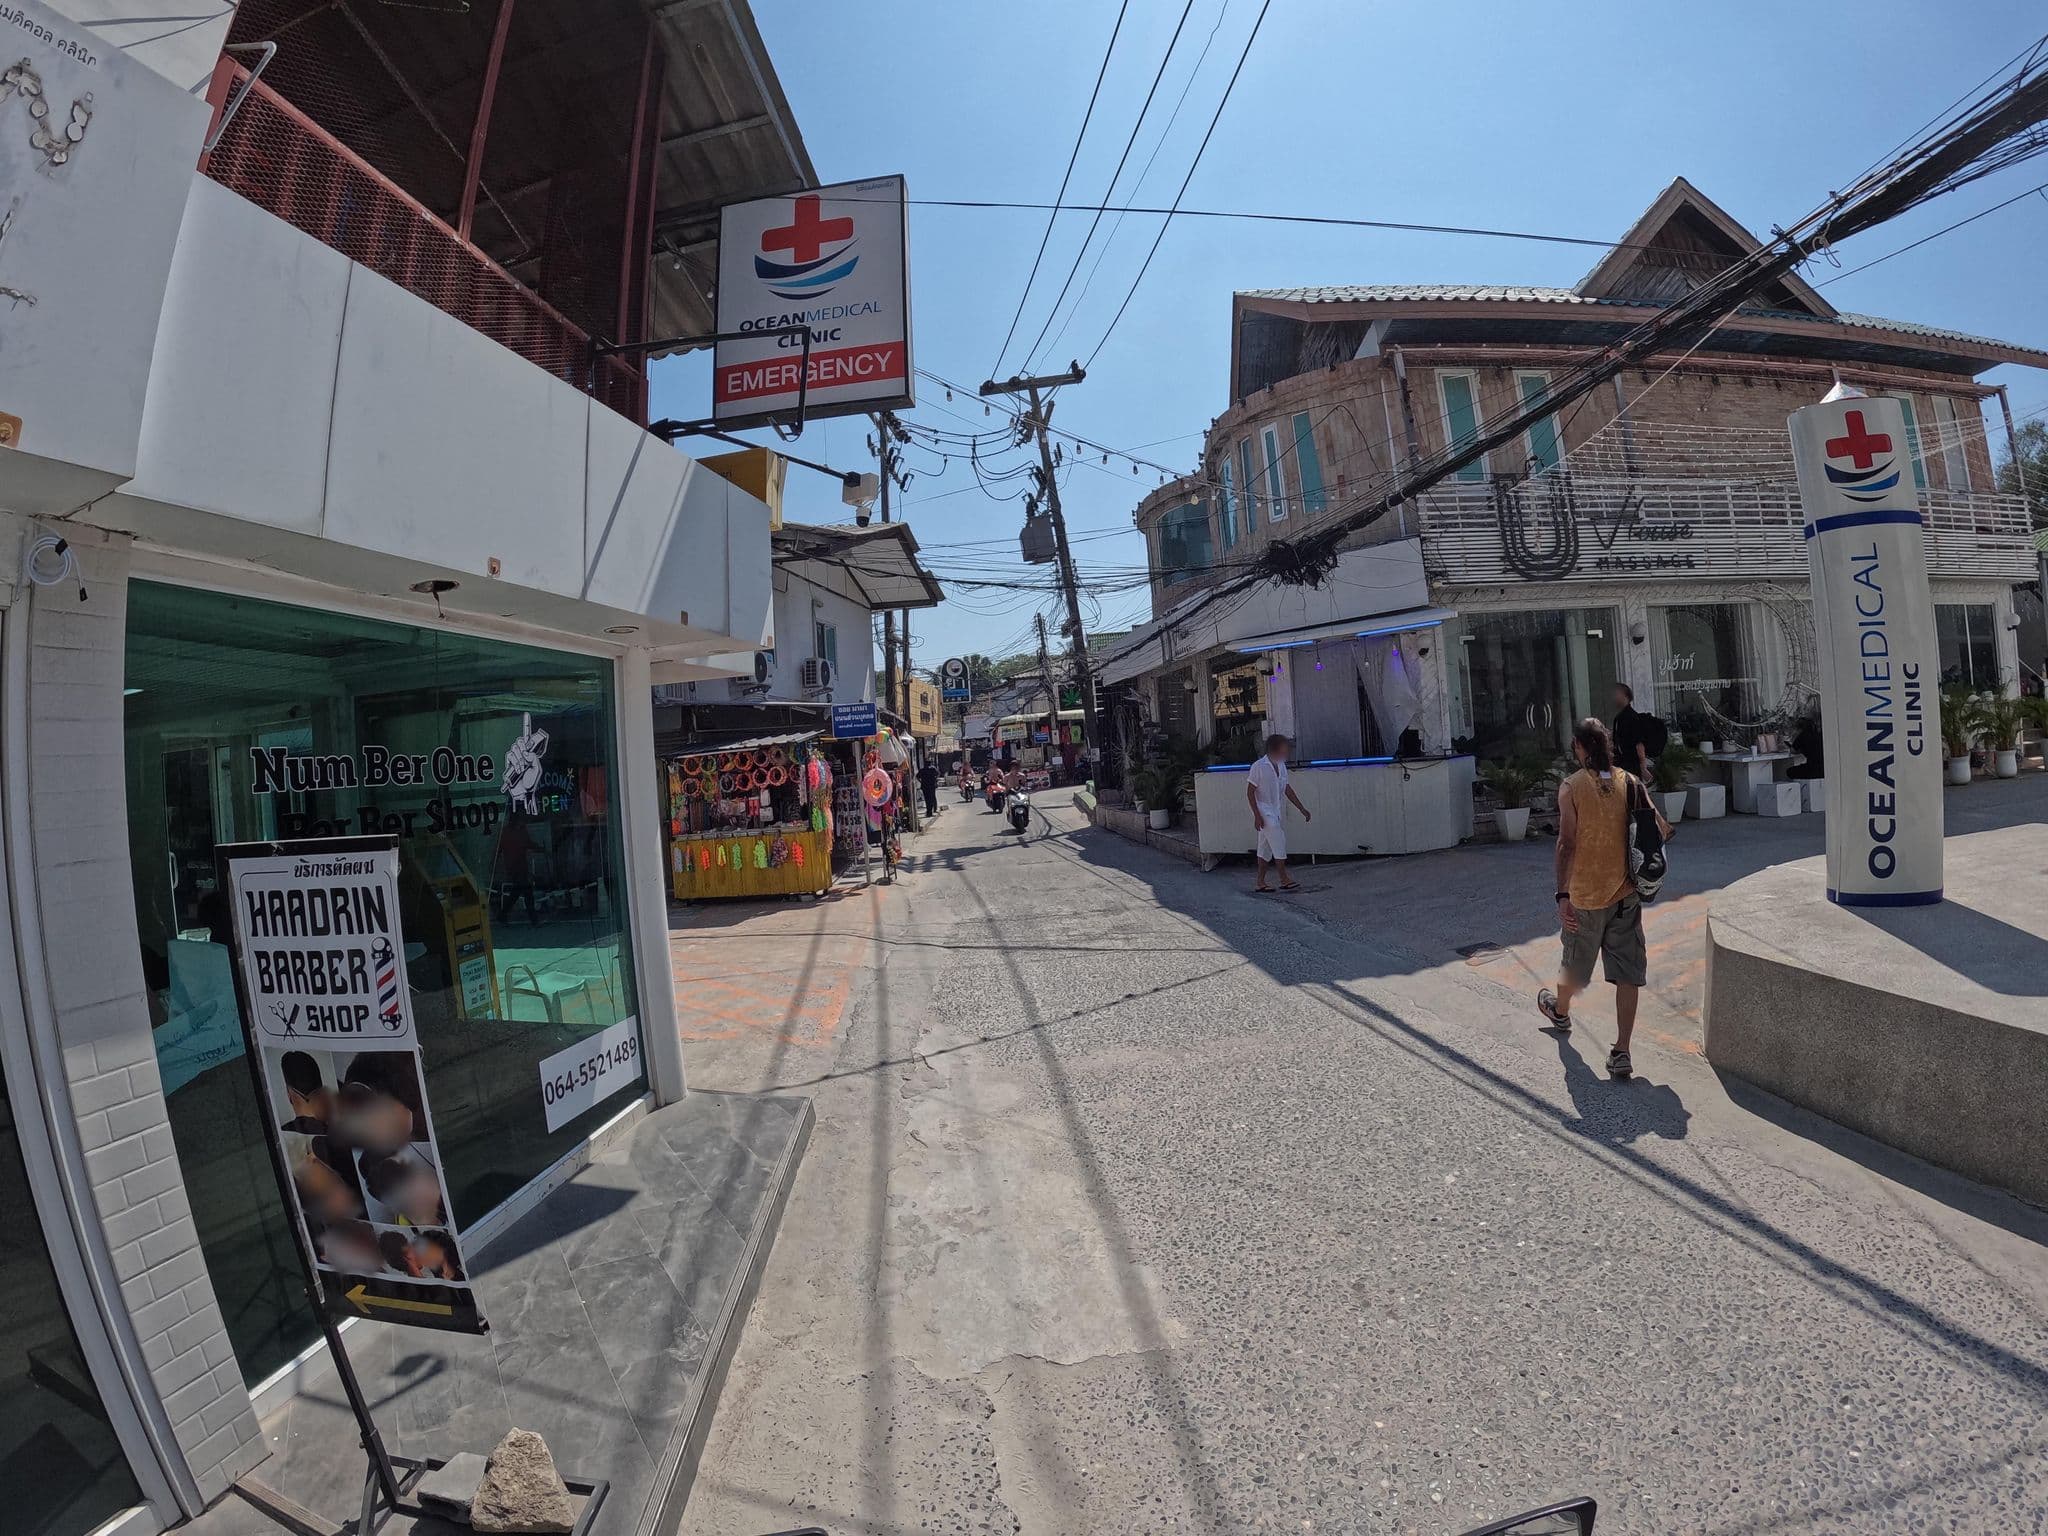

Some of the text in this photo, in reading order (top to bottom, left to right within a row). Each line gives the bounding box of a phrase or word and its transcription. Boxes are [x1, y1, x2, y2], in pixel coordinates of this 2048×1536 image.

[57, 39, 97, 66] คลินิก
[739, 301, 881, 332] OCEANMEDICAL
[777, 328, 841, 348] CLNIC
[727, 350, 893, 394] EMERGENCY
[1596, 554, 1696, 570] MASSAGE
[1850, 542, 1897, 880] OCEANMEDICAL
[1902, 662, 1925, 756] CLINIC
[250, 745, 495, 794] Num Ber One
[425, 798, 500, 836] Shop
[294, 857, 375, 878] บริการตัดผม
[245, 885, 389, 938] HAADRIN
[253, 948, 370, 995] BARBER
[306, 1004, 370, 1032] SHOP
[544, 1036, 637, 1106] 064-5521489
